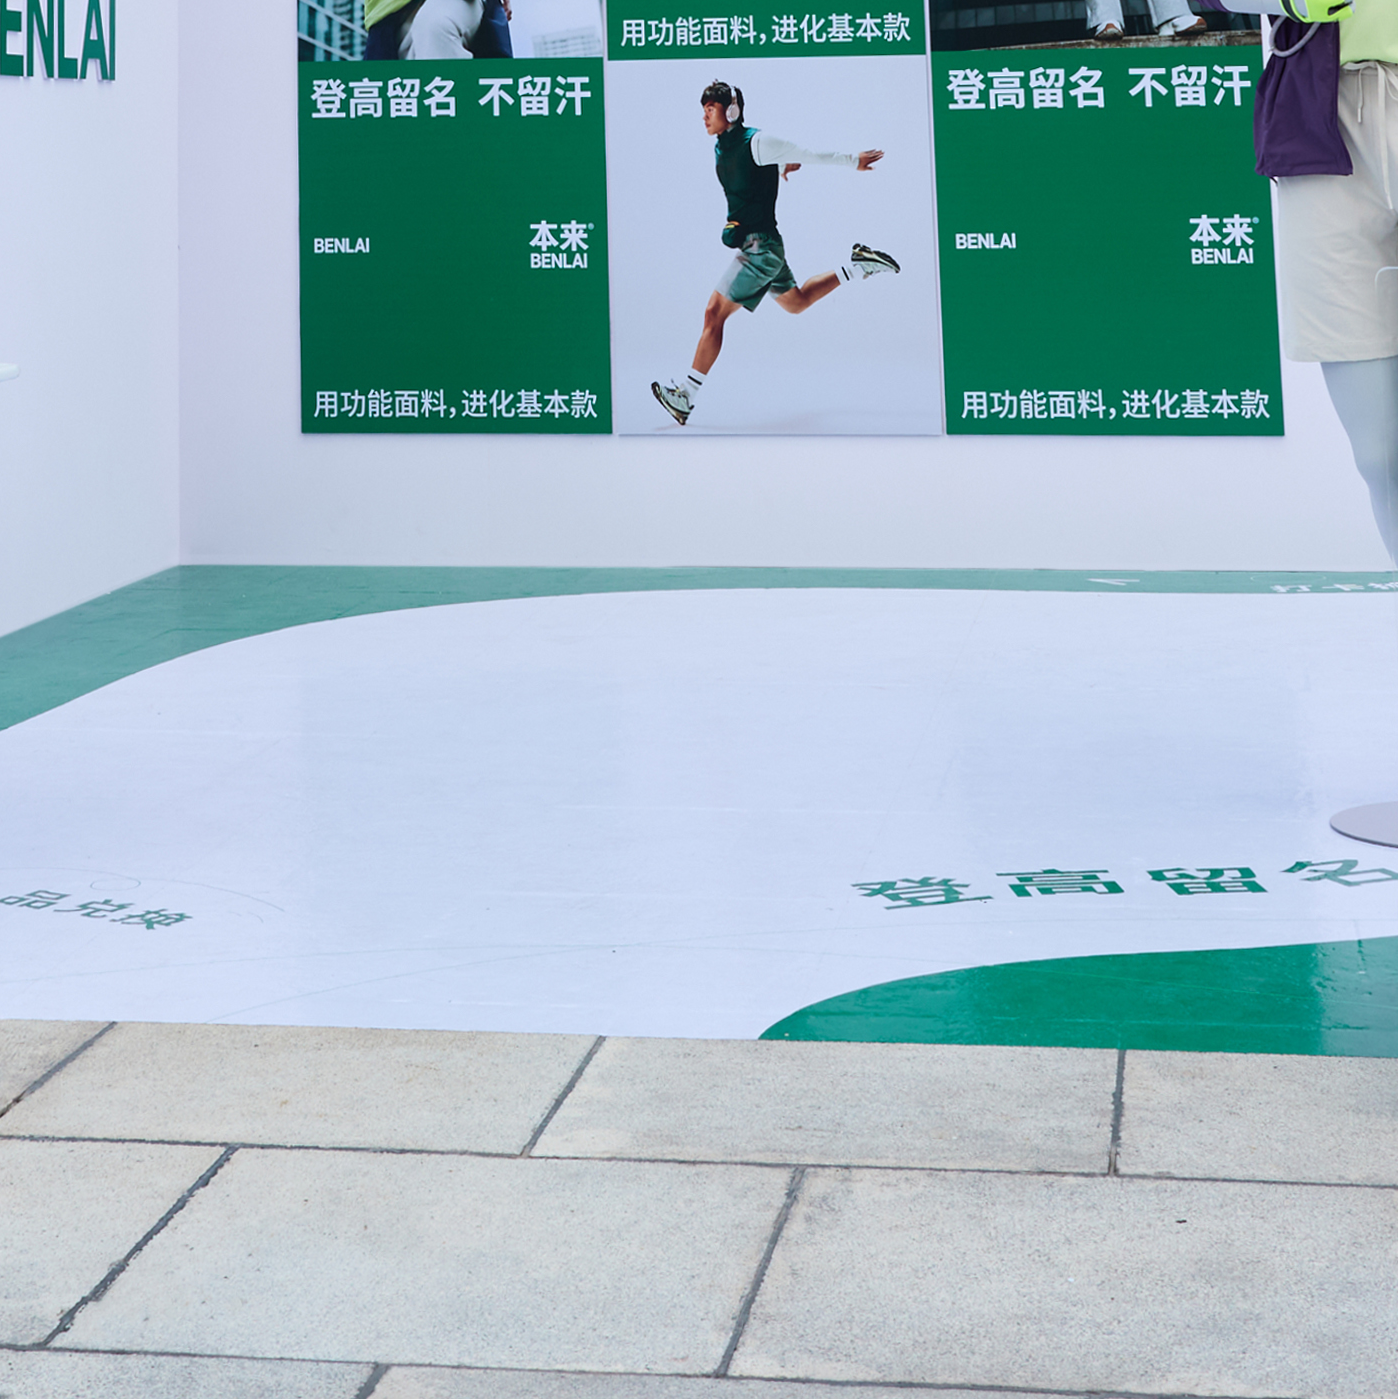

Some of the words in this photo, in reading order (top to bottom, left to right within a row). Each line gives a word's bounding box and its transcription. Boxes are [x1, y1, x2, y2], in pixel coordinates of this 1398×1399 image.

[946, 66, 1105, 110] 登高留名
[1128, 64, 1252, 107] 不留汗
[311, 76, 456, 118] 登高留名
[478, 75, 591, 116] 不留汗
[314, 237, 370, 253] BENLAI
[955, 232, 1017, 249] BENLAI
[530, 253, 588, 269] BENLAI
[1191, 247, 1254, 264] BENLAI
